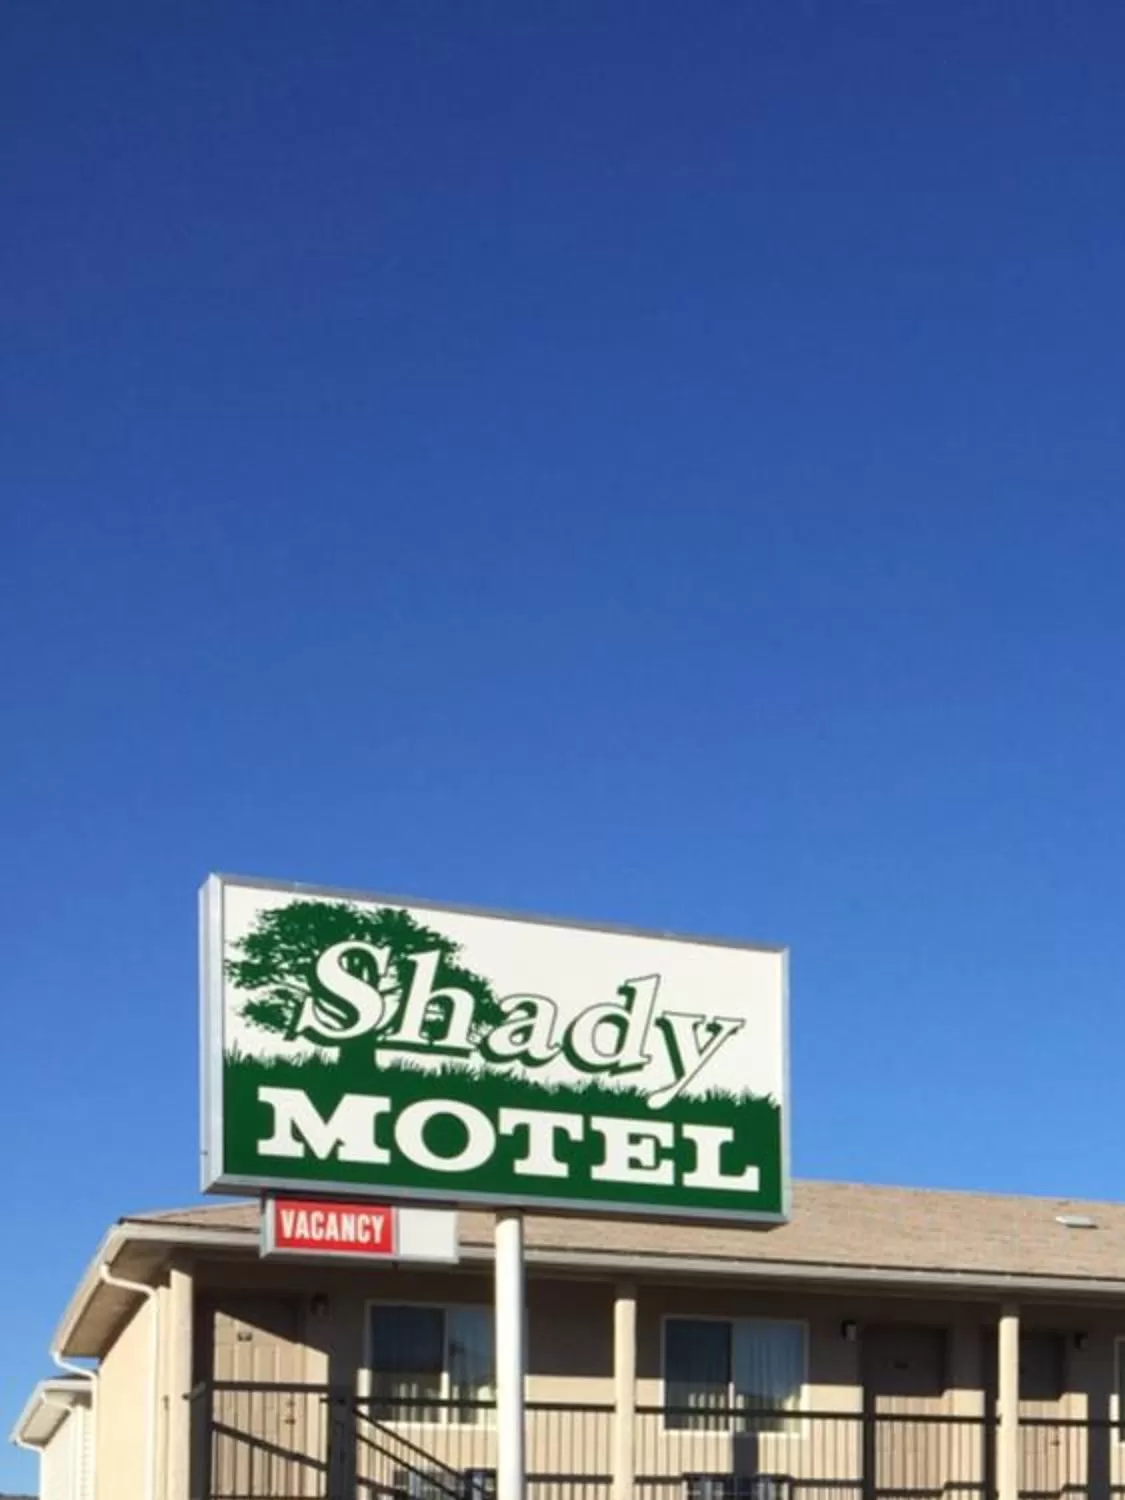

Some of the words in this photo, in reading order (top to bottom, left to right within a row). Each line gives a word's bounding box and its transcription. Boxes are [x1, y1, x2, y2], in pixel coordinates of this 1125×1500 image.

[298, 940, 745, 1109] Shady
[257, 1086, 760, 1192] MOTEL
[280, 1209, 386, 1243] VACANCY
